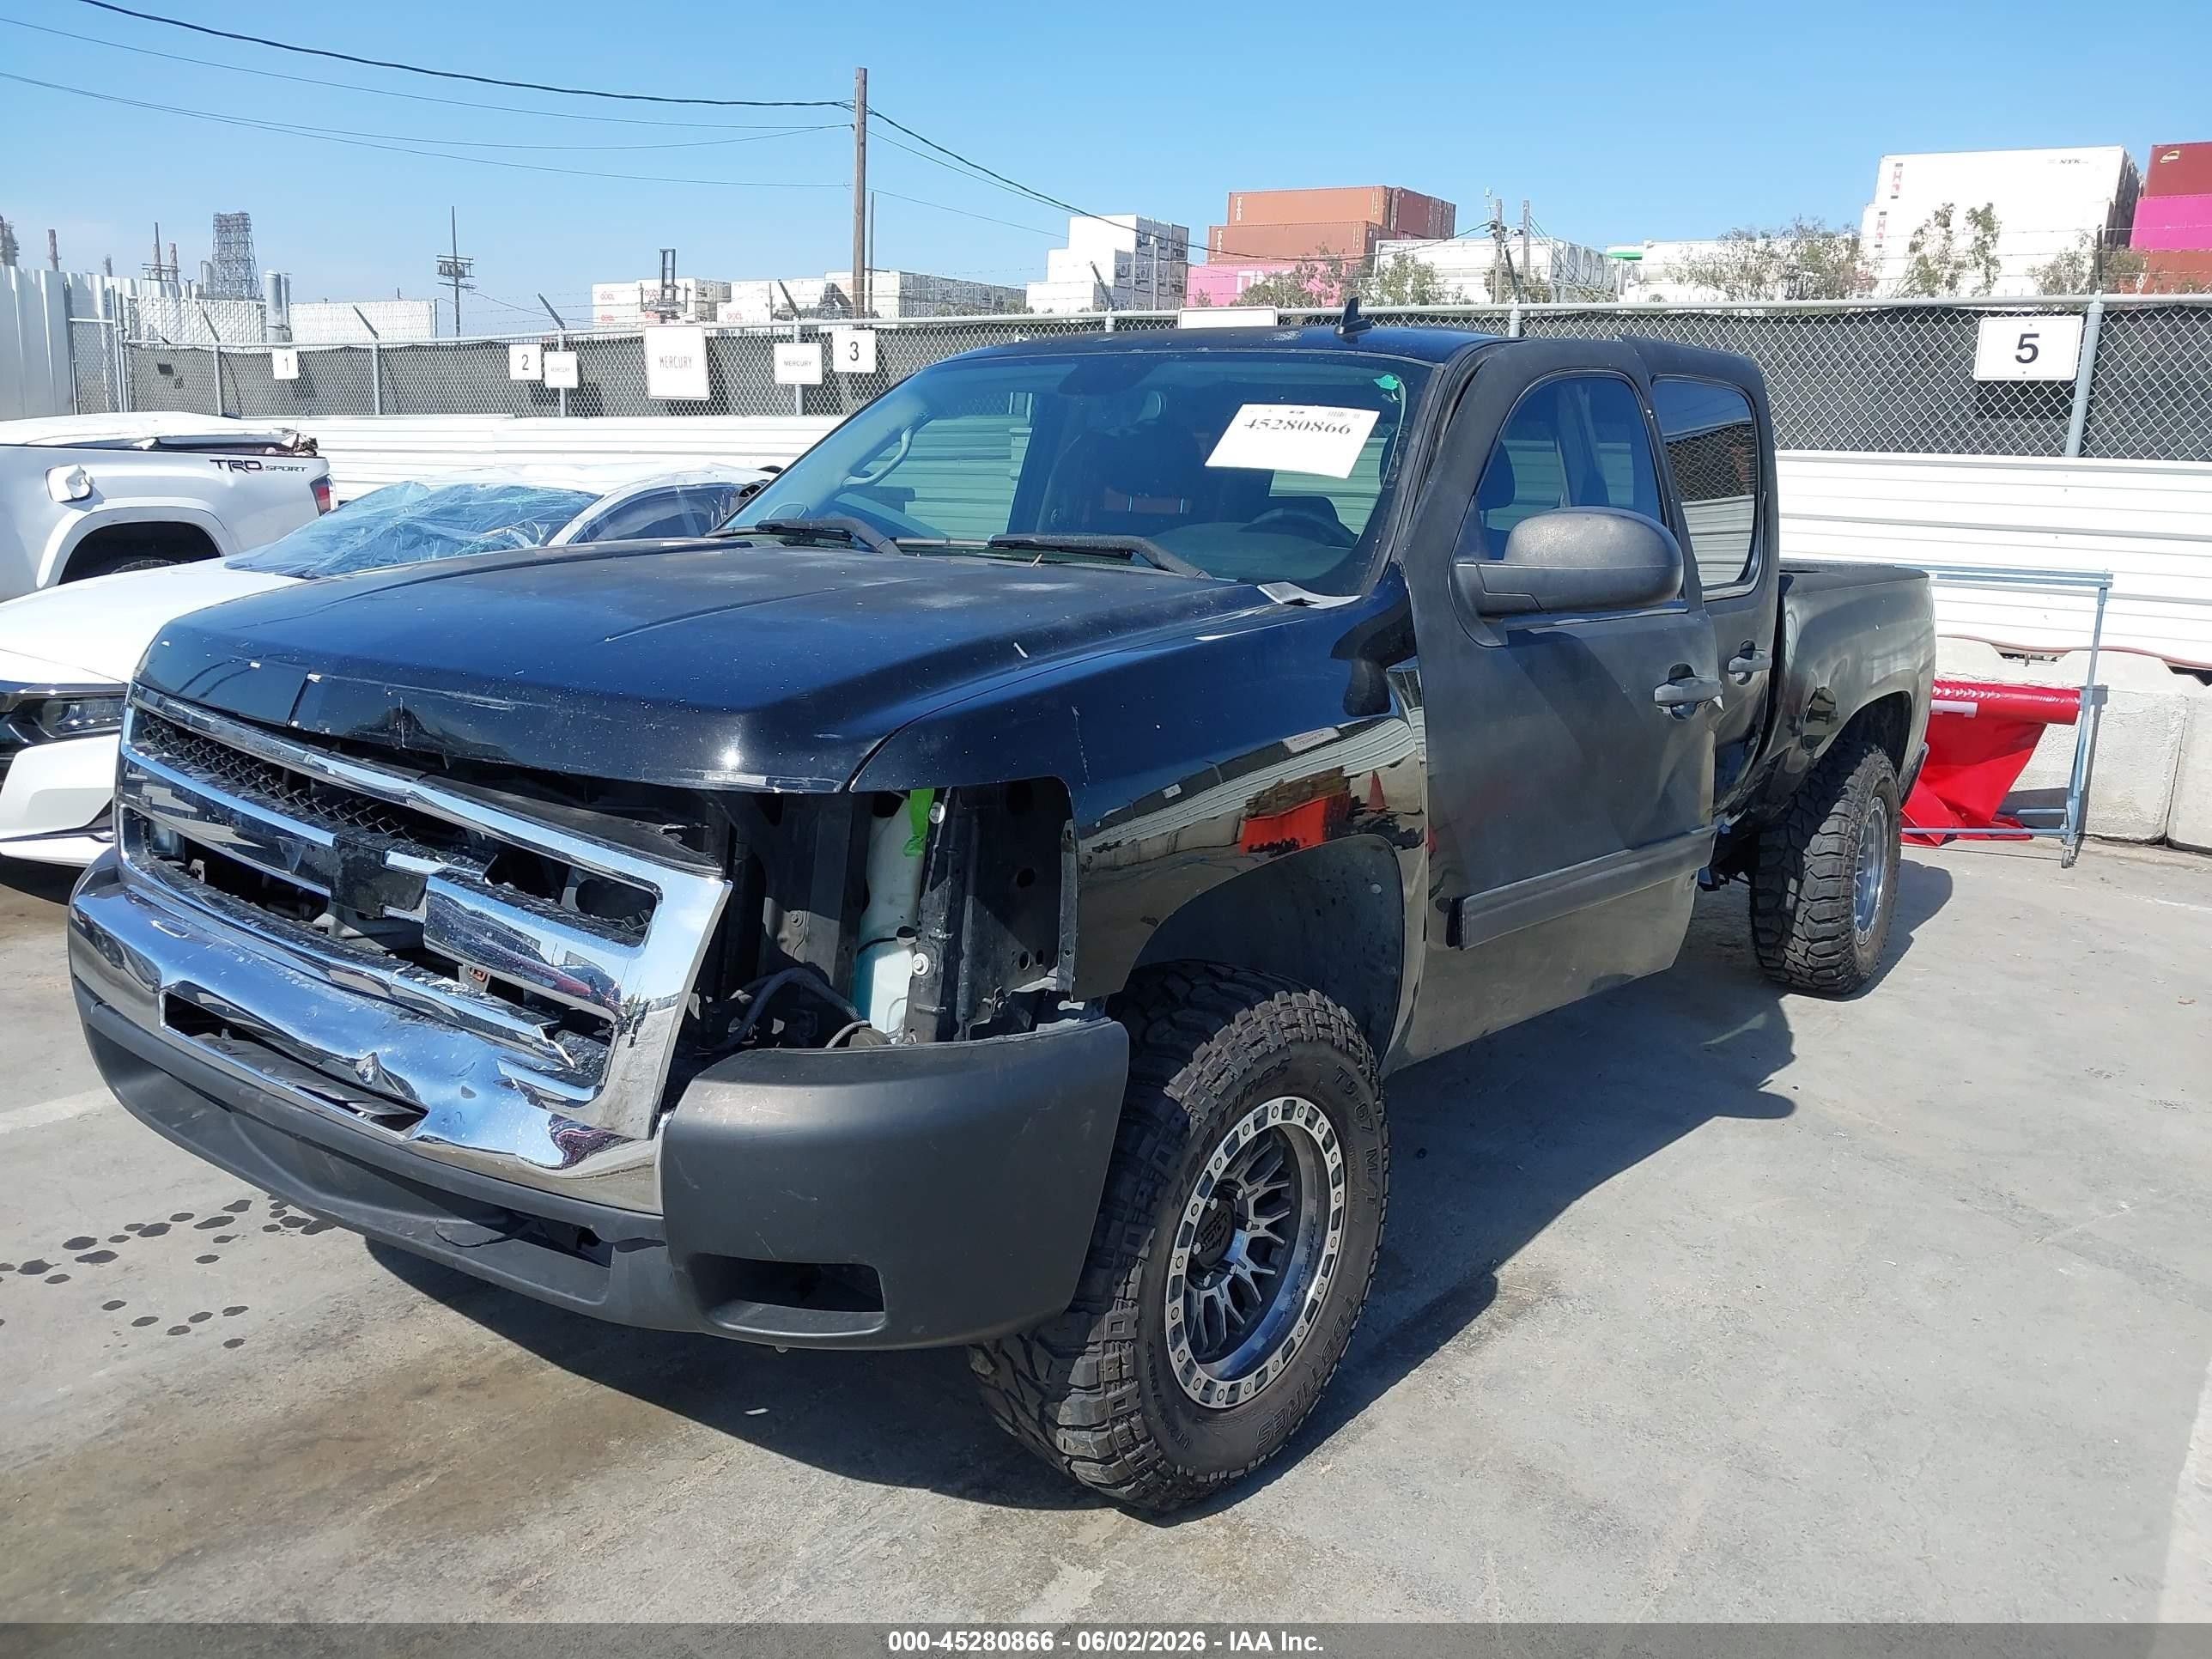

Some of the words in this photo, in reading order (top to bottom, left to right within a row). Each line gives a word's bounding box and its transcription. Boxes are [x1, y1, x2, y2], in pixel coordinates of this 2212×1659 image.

[849, 340, 860, 362] 3
[2014, 332, 2039, 364] 5
[284, 356, 289, 372] 1
[521, 354, 529, 371] 2
[659, 356, 694, 369] MERCURY
[1243, 418, 1352, 435] 45280866
[209, 459, 264, 475] TRD
